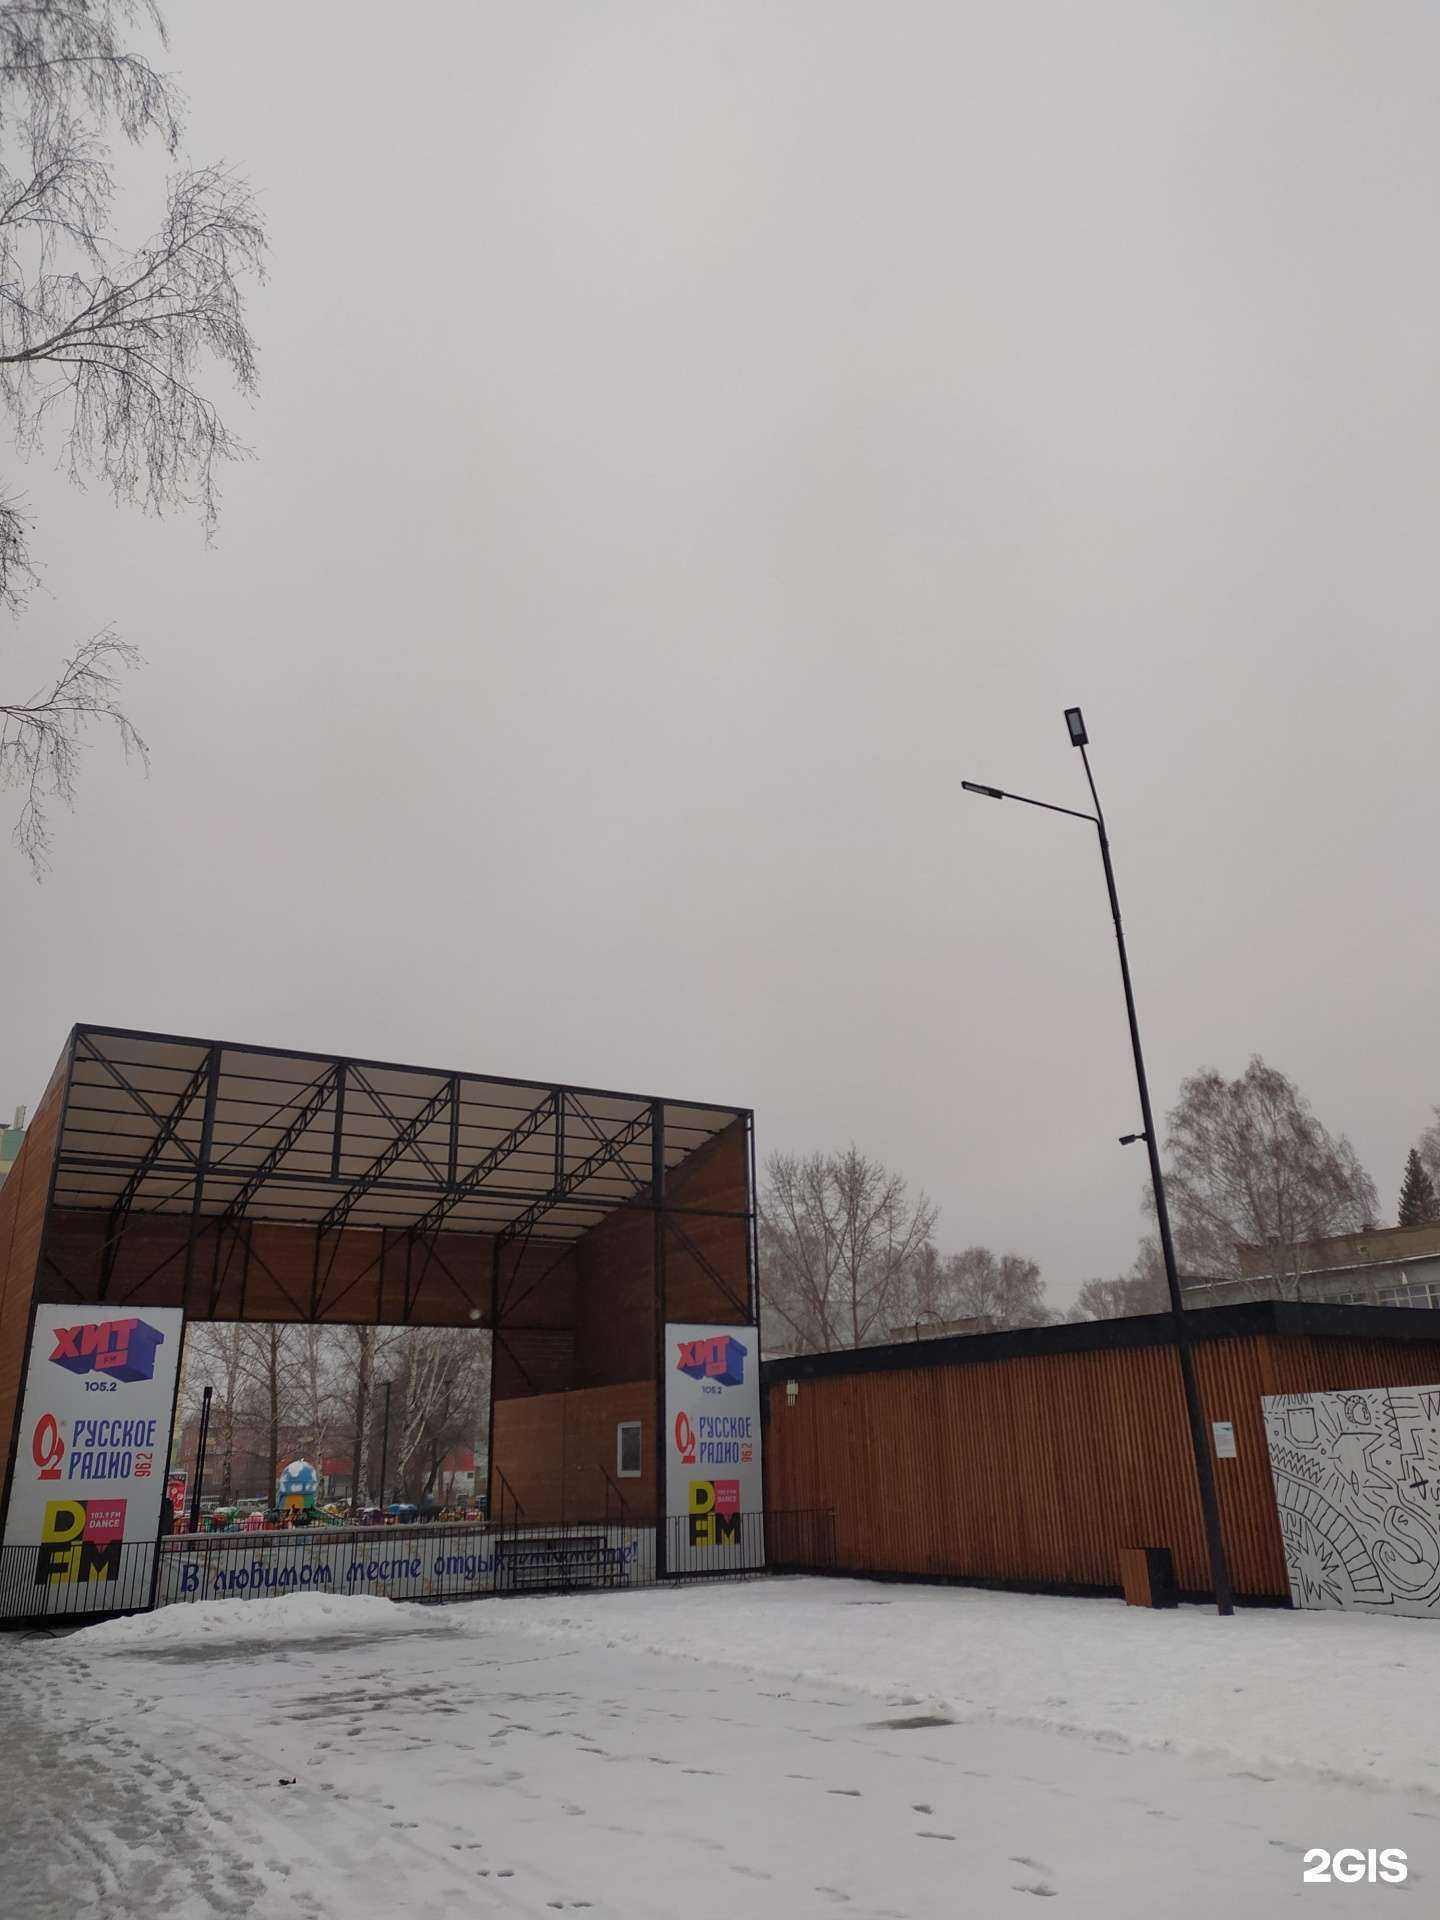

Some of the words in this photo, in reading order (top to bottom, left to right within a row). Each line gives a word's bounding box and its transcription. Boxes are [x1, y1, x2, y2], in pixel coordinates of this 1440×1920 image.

[48, 1318, 139, 1360] ХИТ
[85, 1381, 117, 1392] 105.2
[72, 1420, 157, 1448] РУССКОЕ
[699, 1416, 752, 1438] РУССКОЕ
[68, 1451, 132, 1479] РАДИО
[134, 1453, 153, 1477] 96.2
[700, 1442, 739, 1464] РАДИО
[90, 1519, 120, 1528] DANCE
[181, 1564, 199, 1592] В
[214, 1561, 332, 1591] любимом
